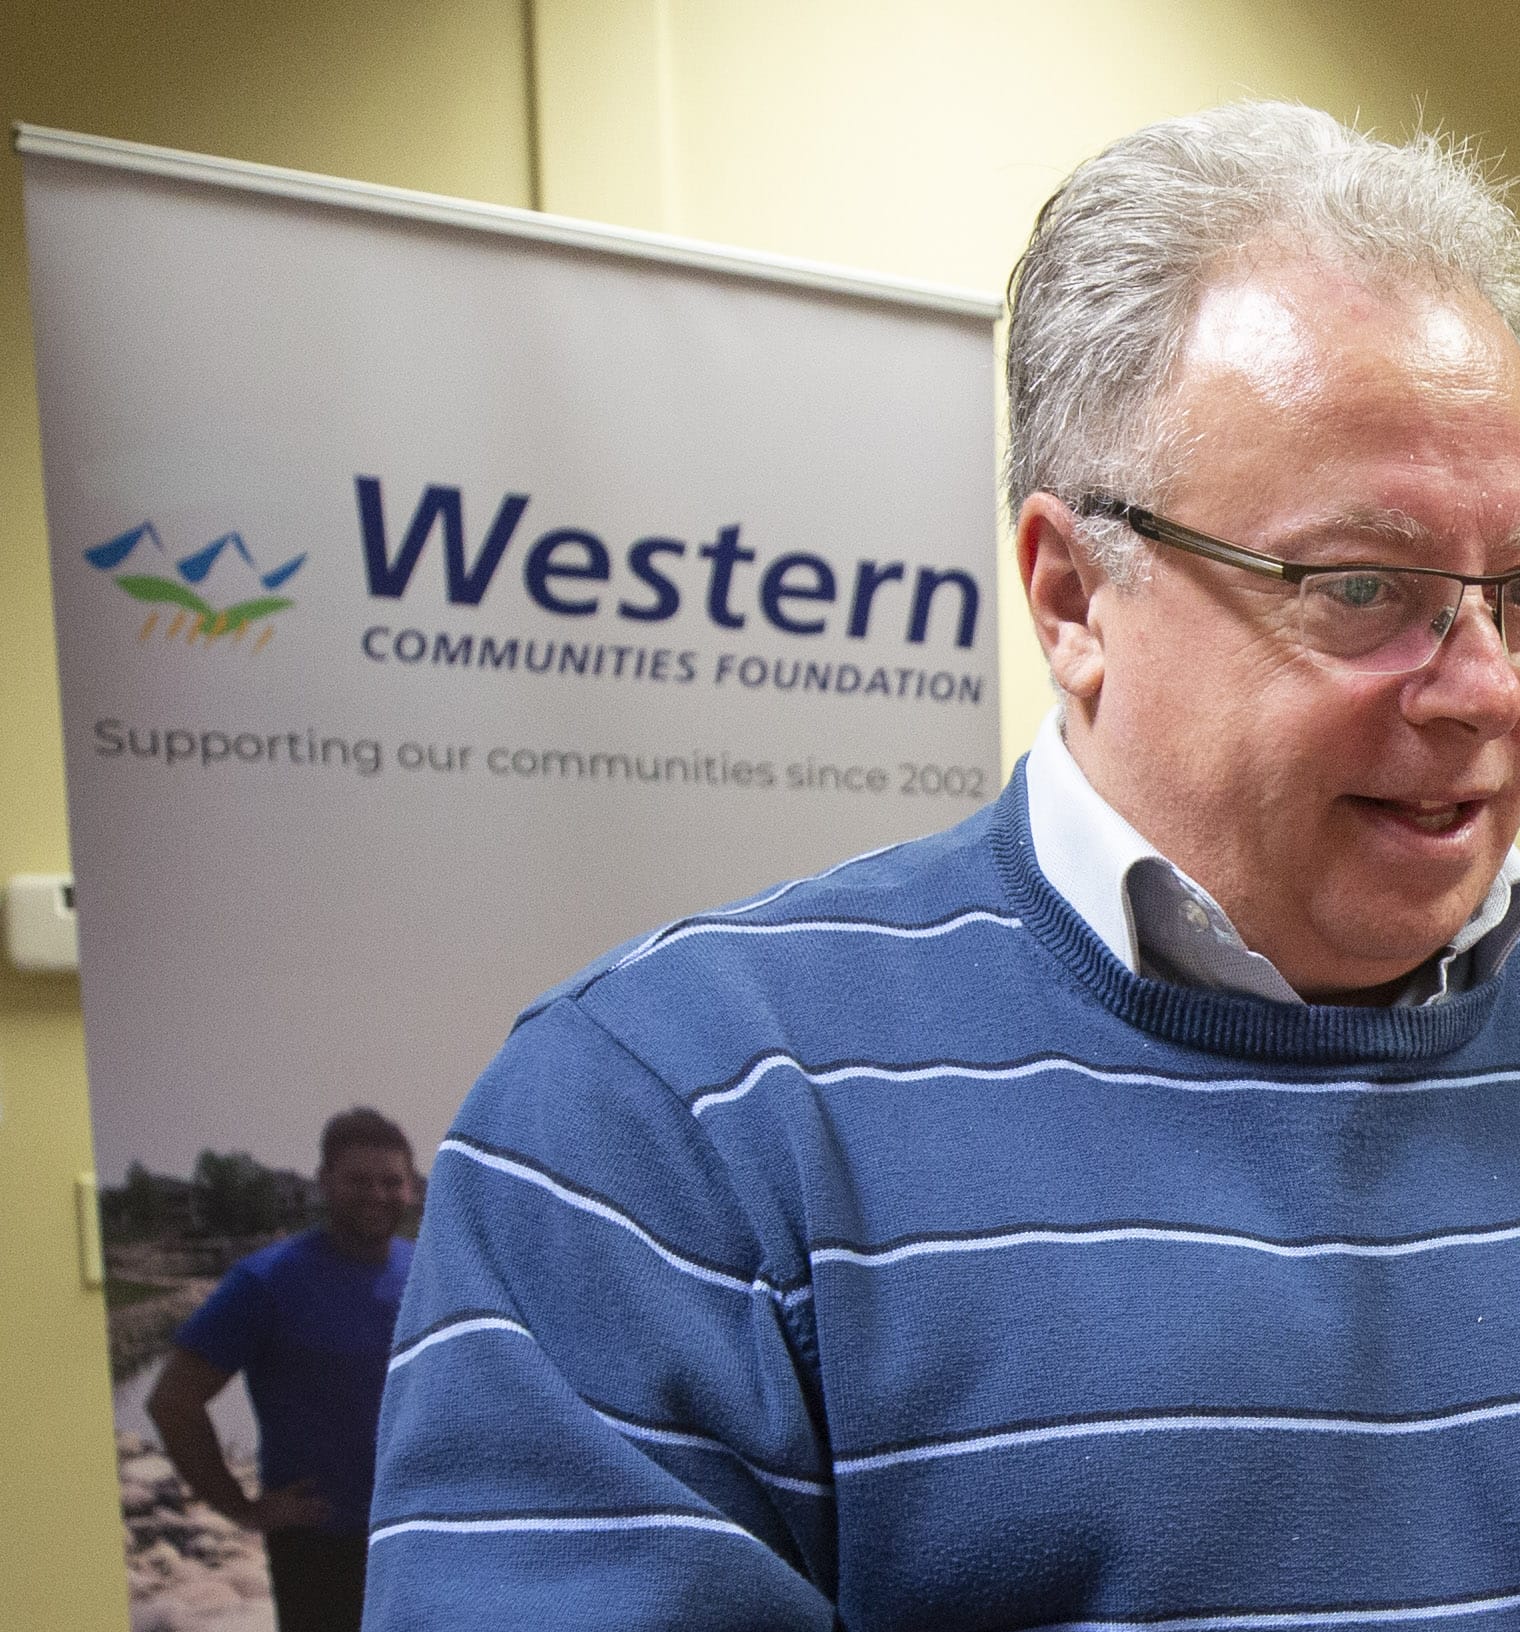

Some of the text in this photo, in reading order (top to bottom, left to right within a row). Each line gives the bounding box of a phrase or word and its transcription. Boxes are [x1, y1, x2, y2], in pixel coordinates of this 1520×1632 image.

[353, 474, 981, 650] Western
[361, 625, 984, 705] COMMUNITIES FOUNDATION
[94, 716, 986, 800] Supporting our communities since 2002
